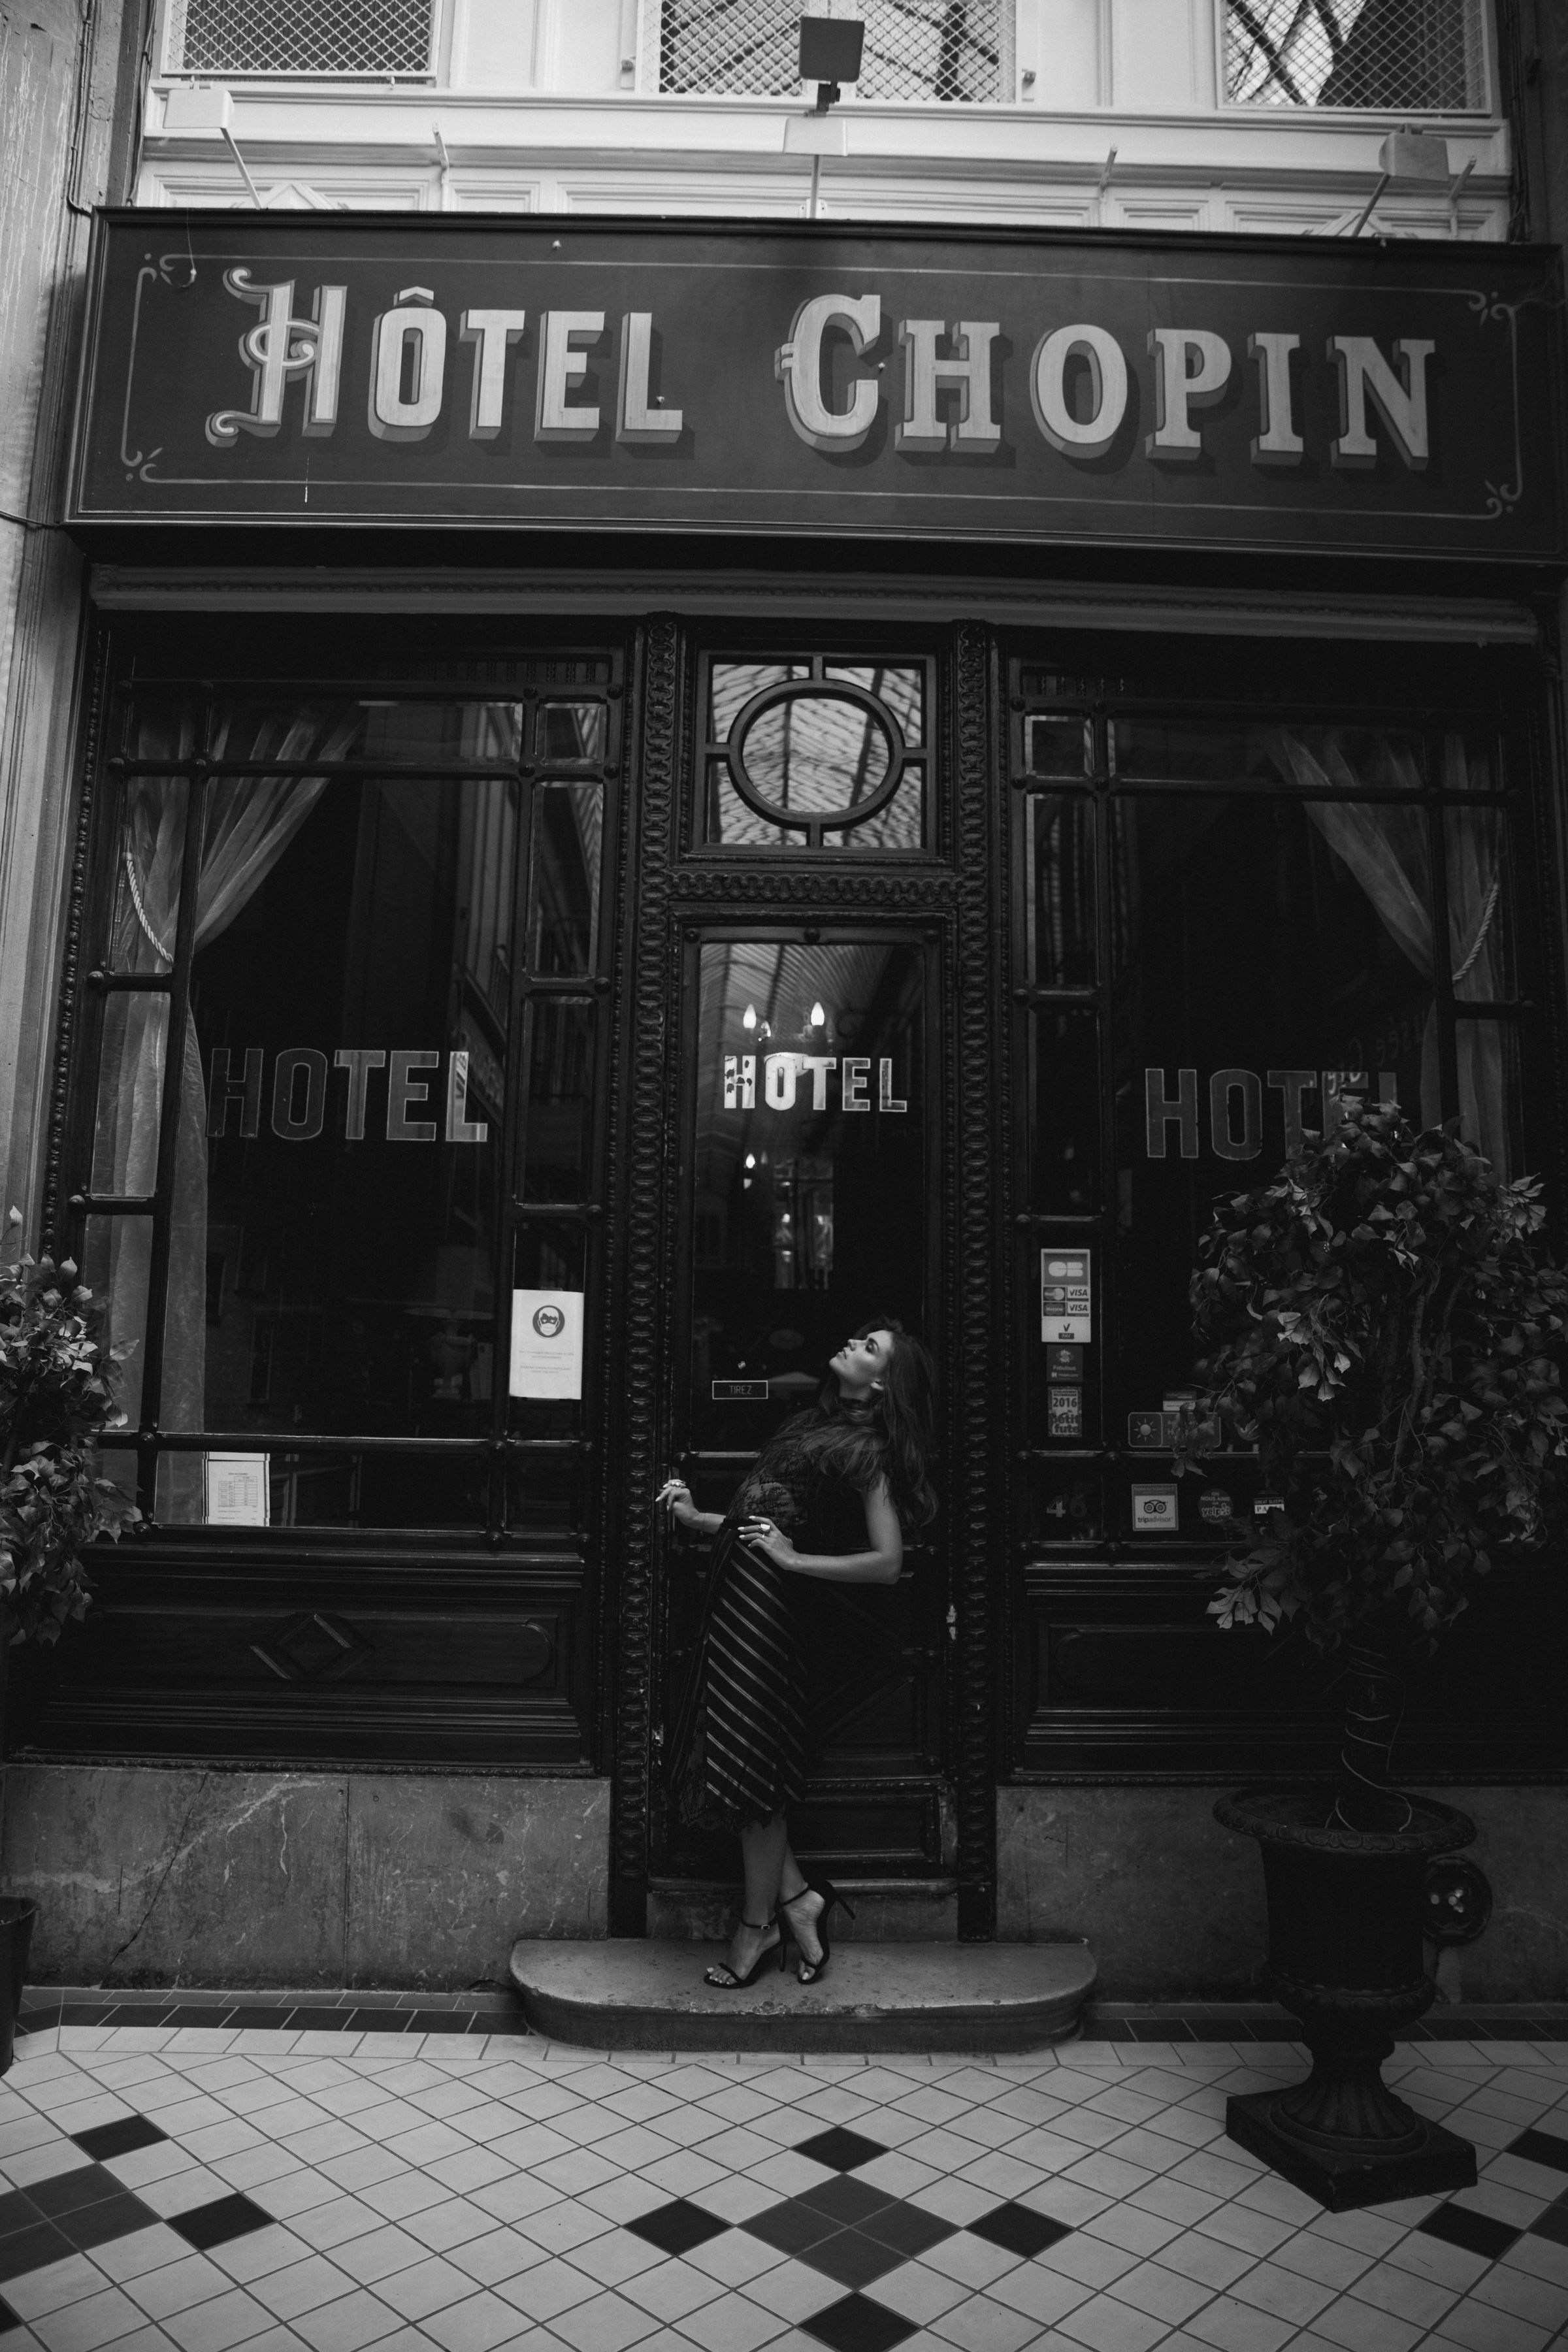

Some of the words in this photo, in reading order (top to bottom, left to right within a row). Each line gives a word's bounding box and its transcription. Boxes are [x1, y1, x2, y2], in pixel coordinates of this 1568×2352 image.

[206, 265, 683, 446] HÔTEL
[774, 293, 1436, 470] CHOPIN
[206, 1047, 488, 1142] HOTEL
[723, 1054, 907, 1113] HOTEL
[1145, 1068, 1397, 1161] HOT
[729, 1385, 752, 1395] TIREZ
[1053, 1397, 1077, 1407] 2016
[1047, 1494, 1088, 1518] 46
[1201, 1506, 1222, 1518] yelp
